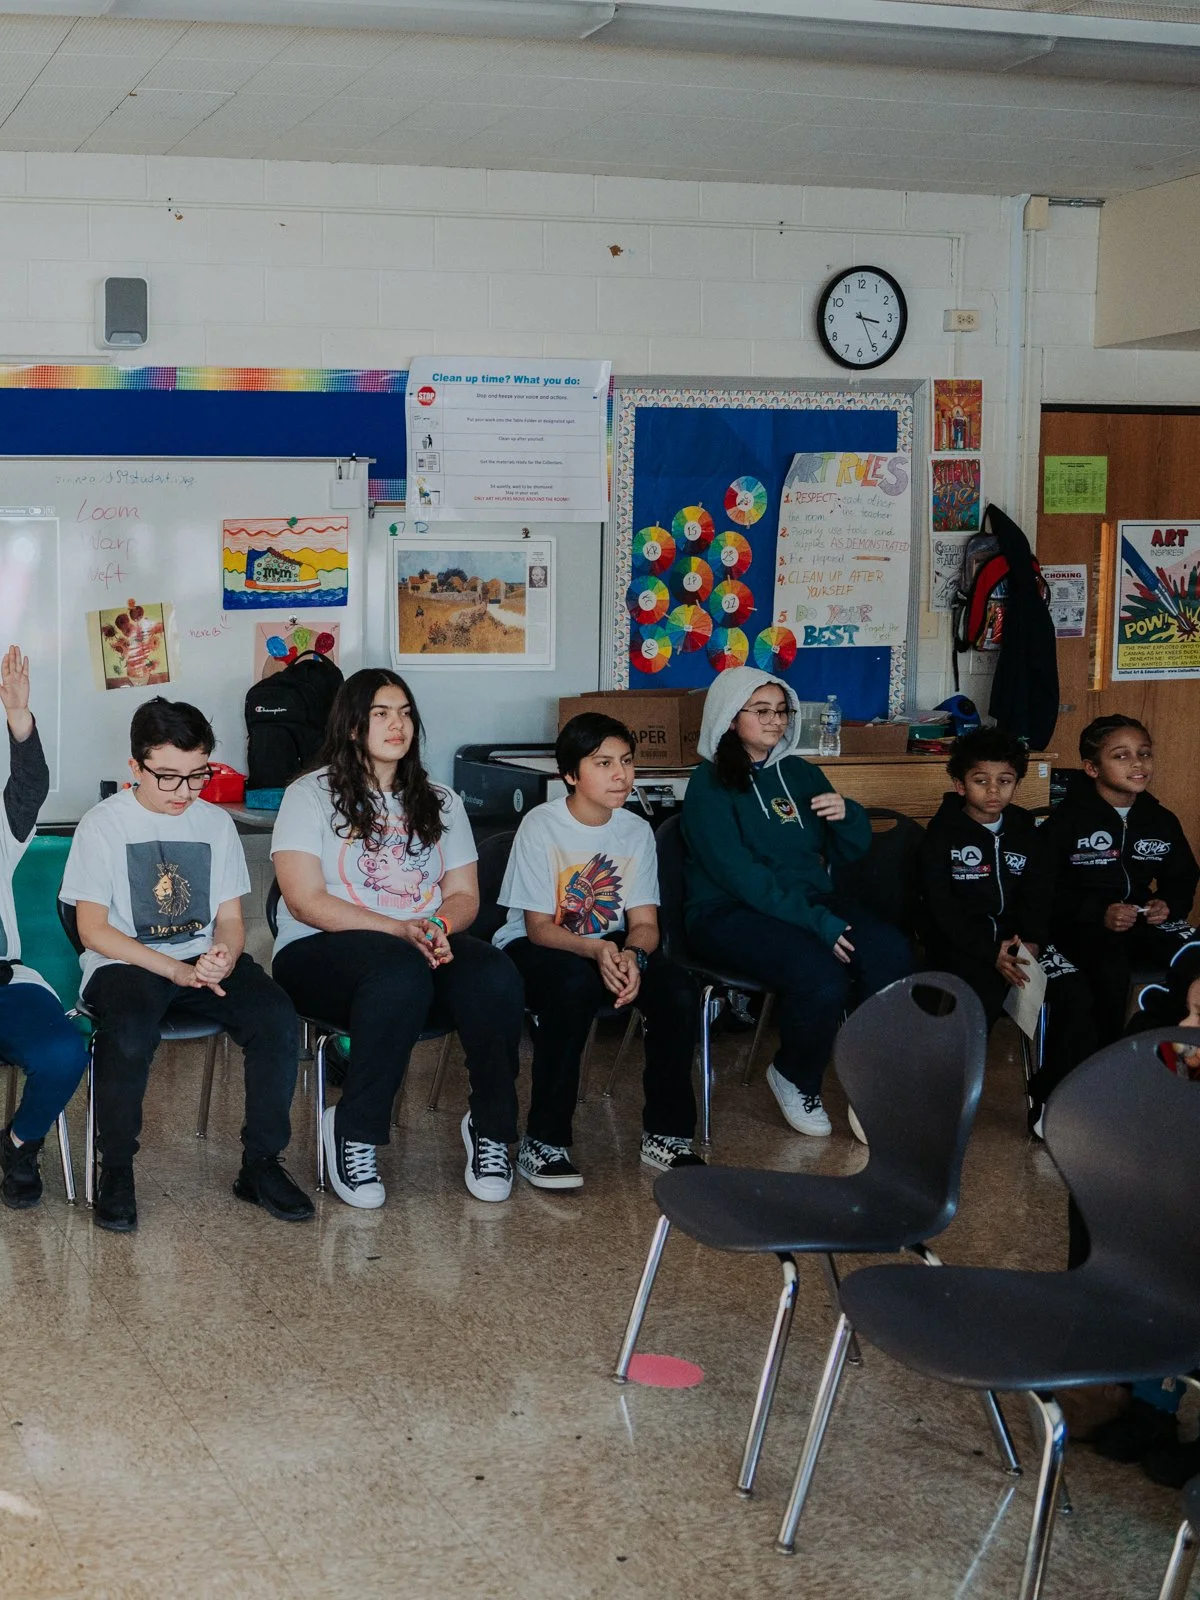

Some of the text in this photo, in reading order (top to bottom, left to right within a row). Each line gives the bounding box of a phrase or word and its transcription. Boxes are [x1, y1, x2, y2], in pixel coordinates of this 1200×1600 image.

[844, 284, 851, 294] 11
[858, 279, 866, 289] 12
[874, 284, 878, 293] 1
[832, 298, 844, 307] 10
[883, 296, 889, 305] 2
[828, 315, 835, 324] 9
[887, 313, 893, 322] 3
[831, 332, 838, 341] 8
[881, 330, 888, 339] 4
[844, 344, 850, 353] 7
[871, 343, 878, 352] 5
[856, 348, 863, 358] 6
[432, 373, 580, 387] Clean up time? What you do:
[418, 392, 435, 400] STOP
[785, 453, 836, 489] ART
[836, 452, 909, 496] RULES
[796, 491, 837, 504] RESPECT
[77, 499, 141, 523] Loom
[780, 527, 789, 537] 2.
[1151, 529, 1188, 547] ART
[777, 570, 884, 585] 4. CLEAN UP AFTER
[807, 585, 854, 599] YOURSELF
[1125, 613, 1169, 639] POW!
[803, 625, 860, 646] BEST
[255, 706, 287, 715] Champion
[631, 730, 666, 744] APER
